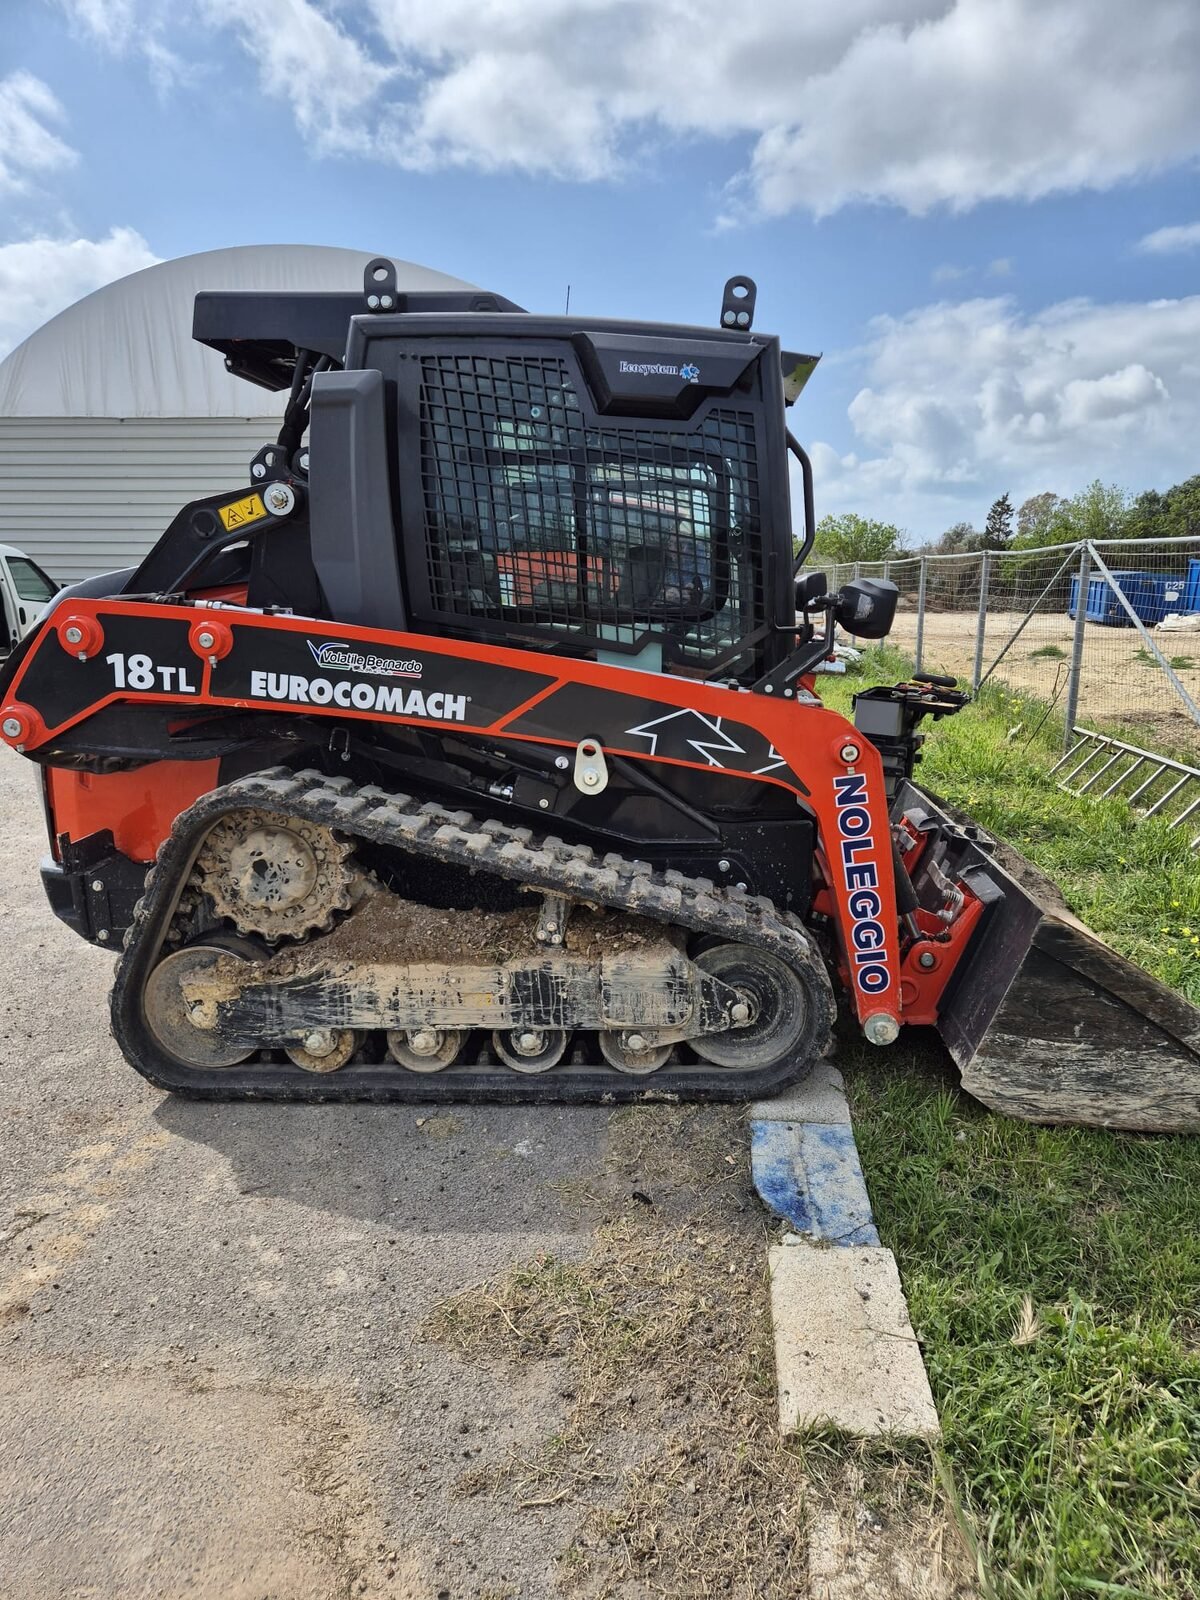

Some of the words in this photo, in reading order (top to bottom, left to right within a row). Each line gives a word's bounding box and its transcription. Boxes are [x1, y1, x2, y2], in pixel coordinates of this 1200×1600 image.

[619, 361, 678, 376] Ecosystem
[322, 651, 364, 666] Volatile
[366, 655, 422, 672] Bernardo
[251, 670, 466, 721] EUROCOMACH
[833, 773, 891, 994] NOLEGGIO
